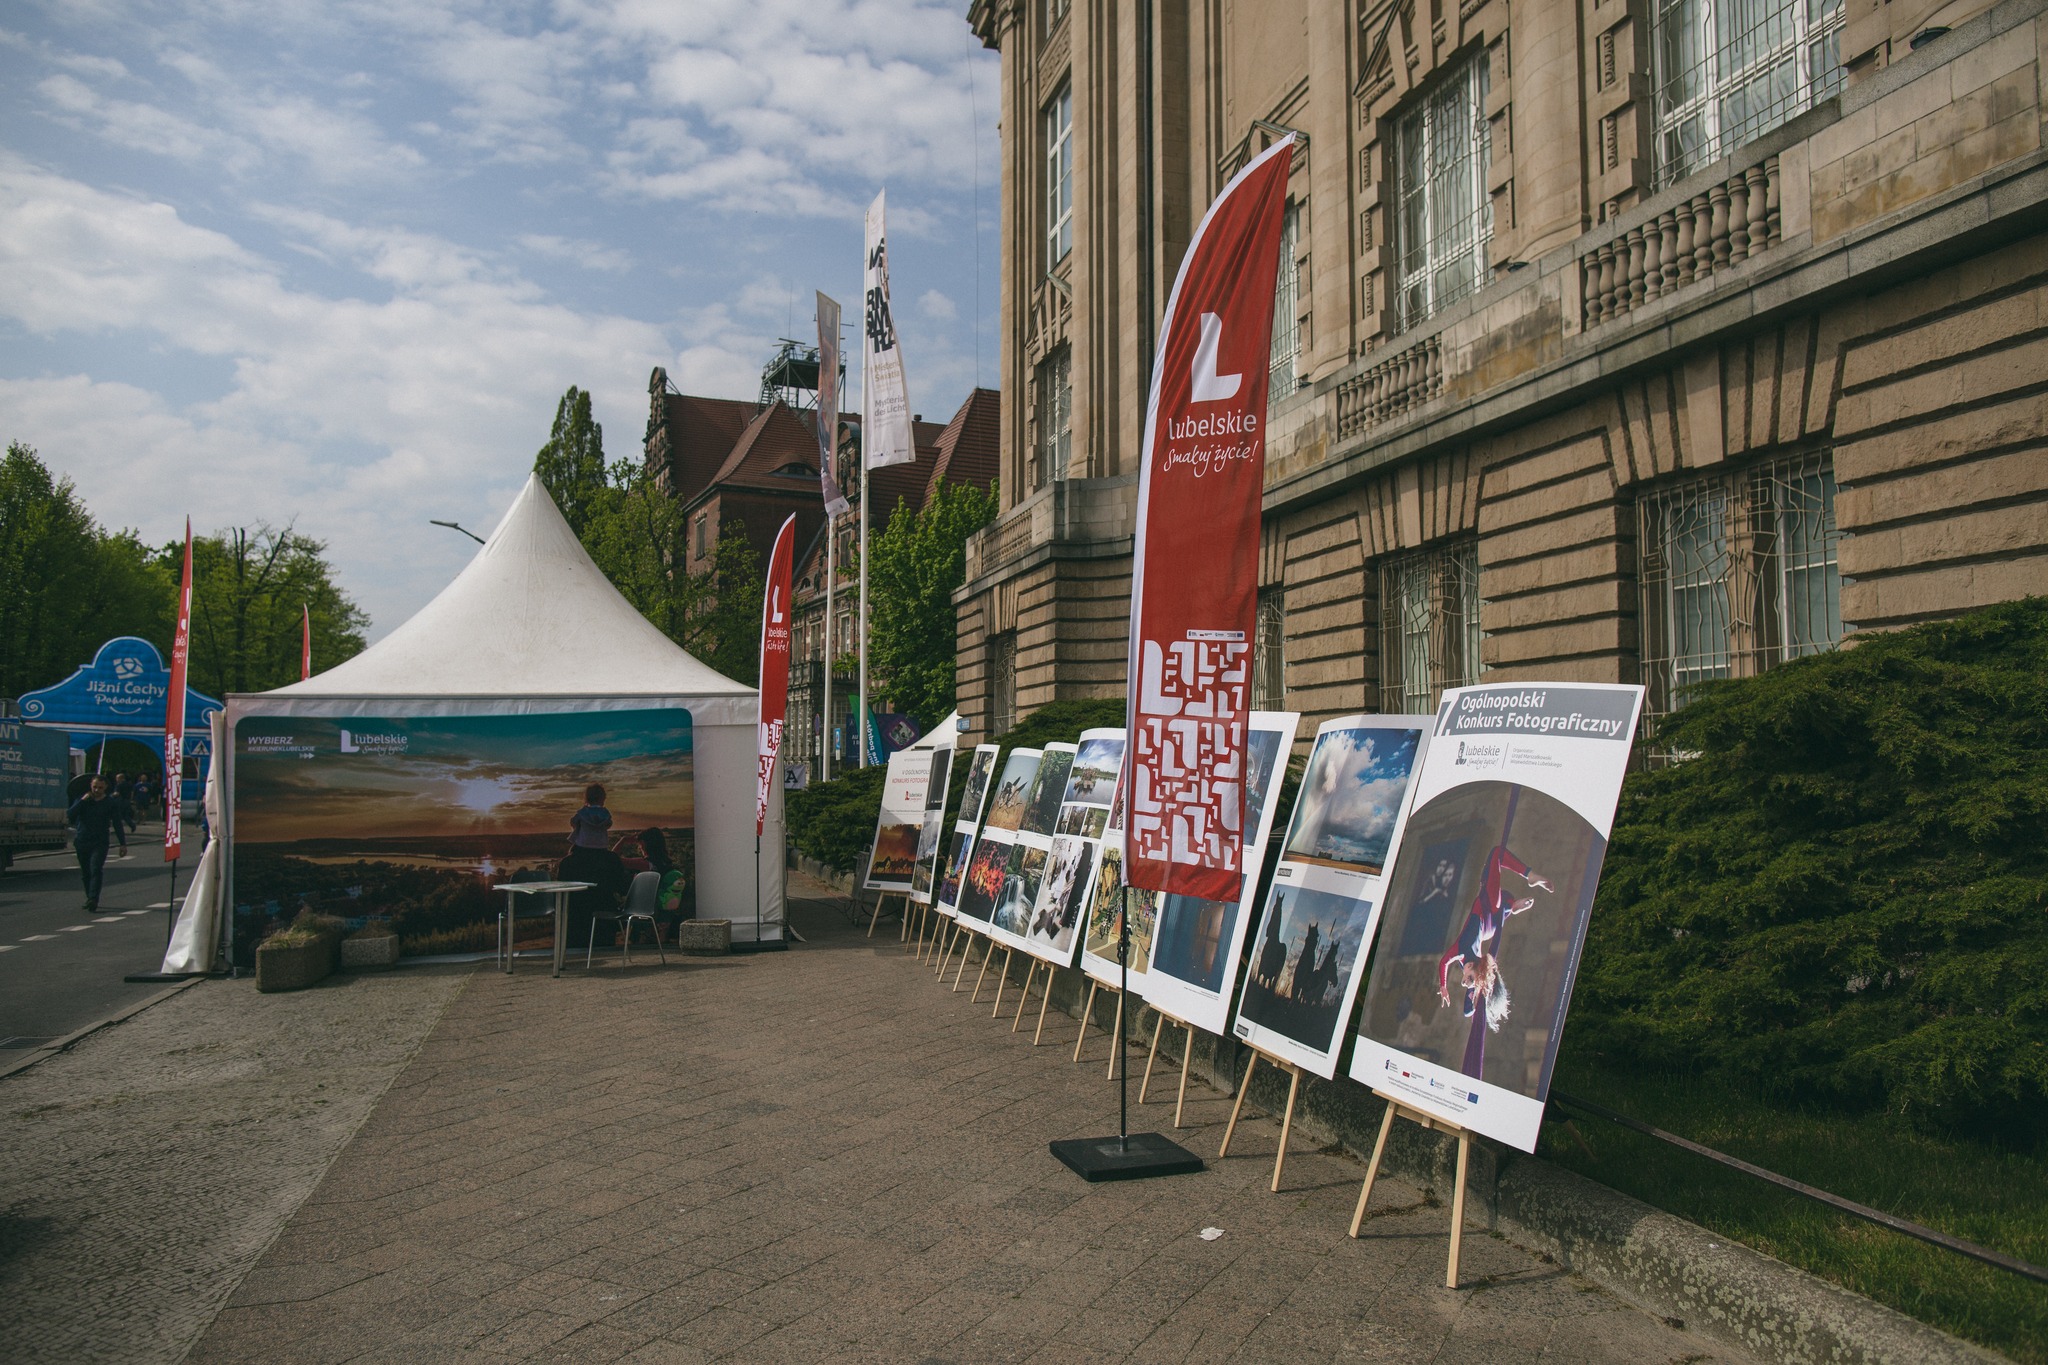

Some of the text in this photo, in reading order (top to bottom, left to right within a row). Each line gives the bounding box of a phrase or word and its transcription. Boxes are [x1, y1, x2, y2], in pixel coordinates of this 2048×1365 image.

[1168, 409, 1257, 440] lubelskie
[1213, 440, 1259, 472] życie!
[86, 680, 166, 698] Jižní Čechy
[1461, 691, 1547, 713] Ogólnopolski
[1456, 712, 1623, 737] Konkurs Fotograficzny
[248, 736, 293, 745] WYBIERZ
[355, 734, 408, 744] lubelskie
[1465, 745, 1500, 756] lubelskie
